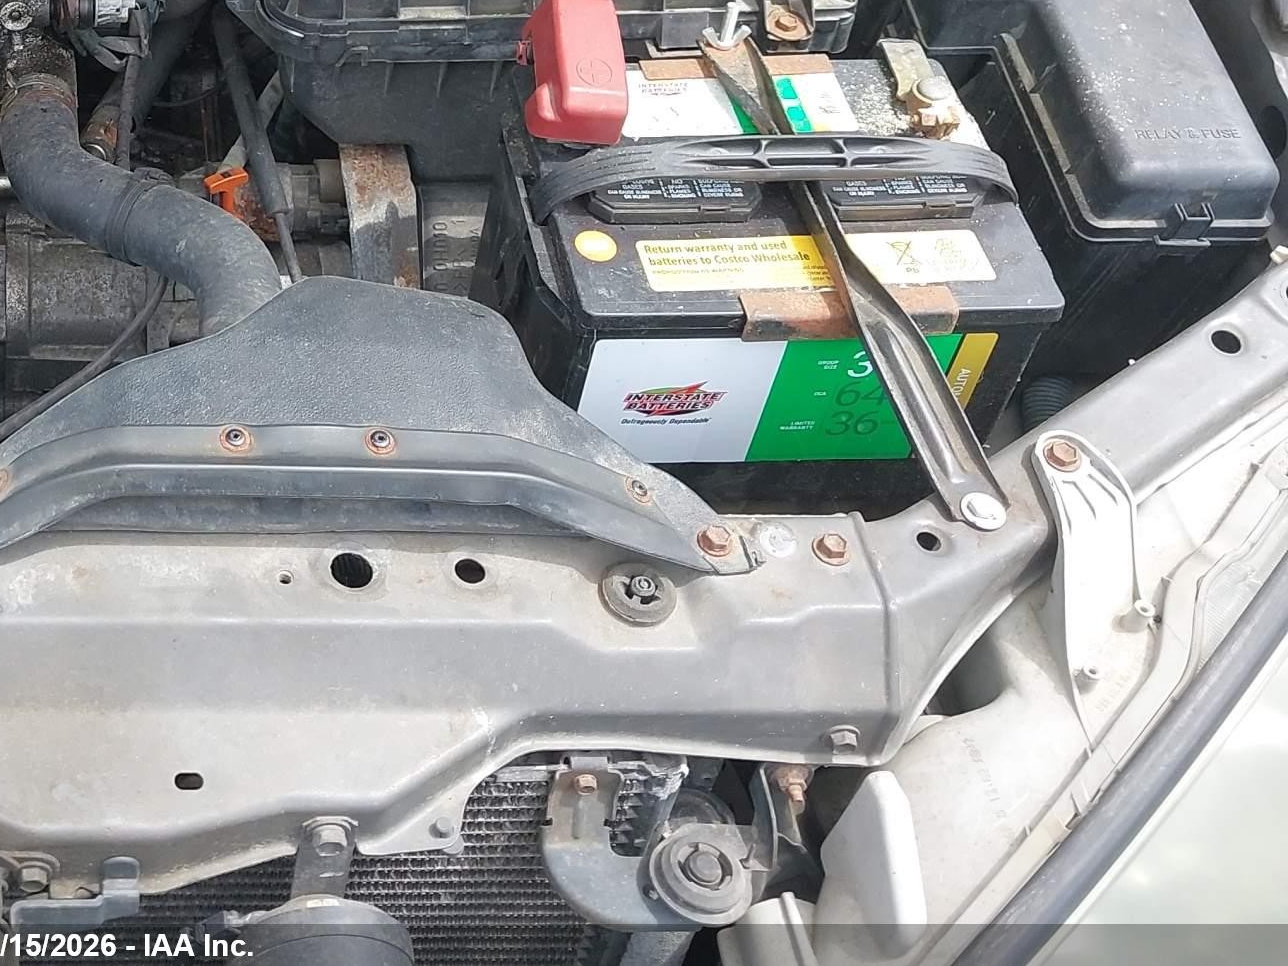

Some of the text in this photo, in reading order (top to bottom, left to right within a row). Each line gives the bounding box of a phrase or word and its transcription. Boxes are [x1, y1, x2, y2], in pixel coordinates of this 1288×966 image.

[1134, 129, 1182, 139] RELAY
[1201, 129, 1242, 139] FUSE
[644, 240, 788, 253] Return warranty and used
[649, 251, 811, 266] batteries to Costco Wholesale
[625, 393, 722, 402] INTERSTATE
[626, 401, 711, 410] BATTERIES
